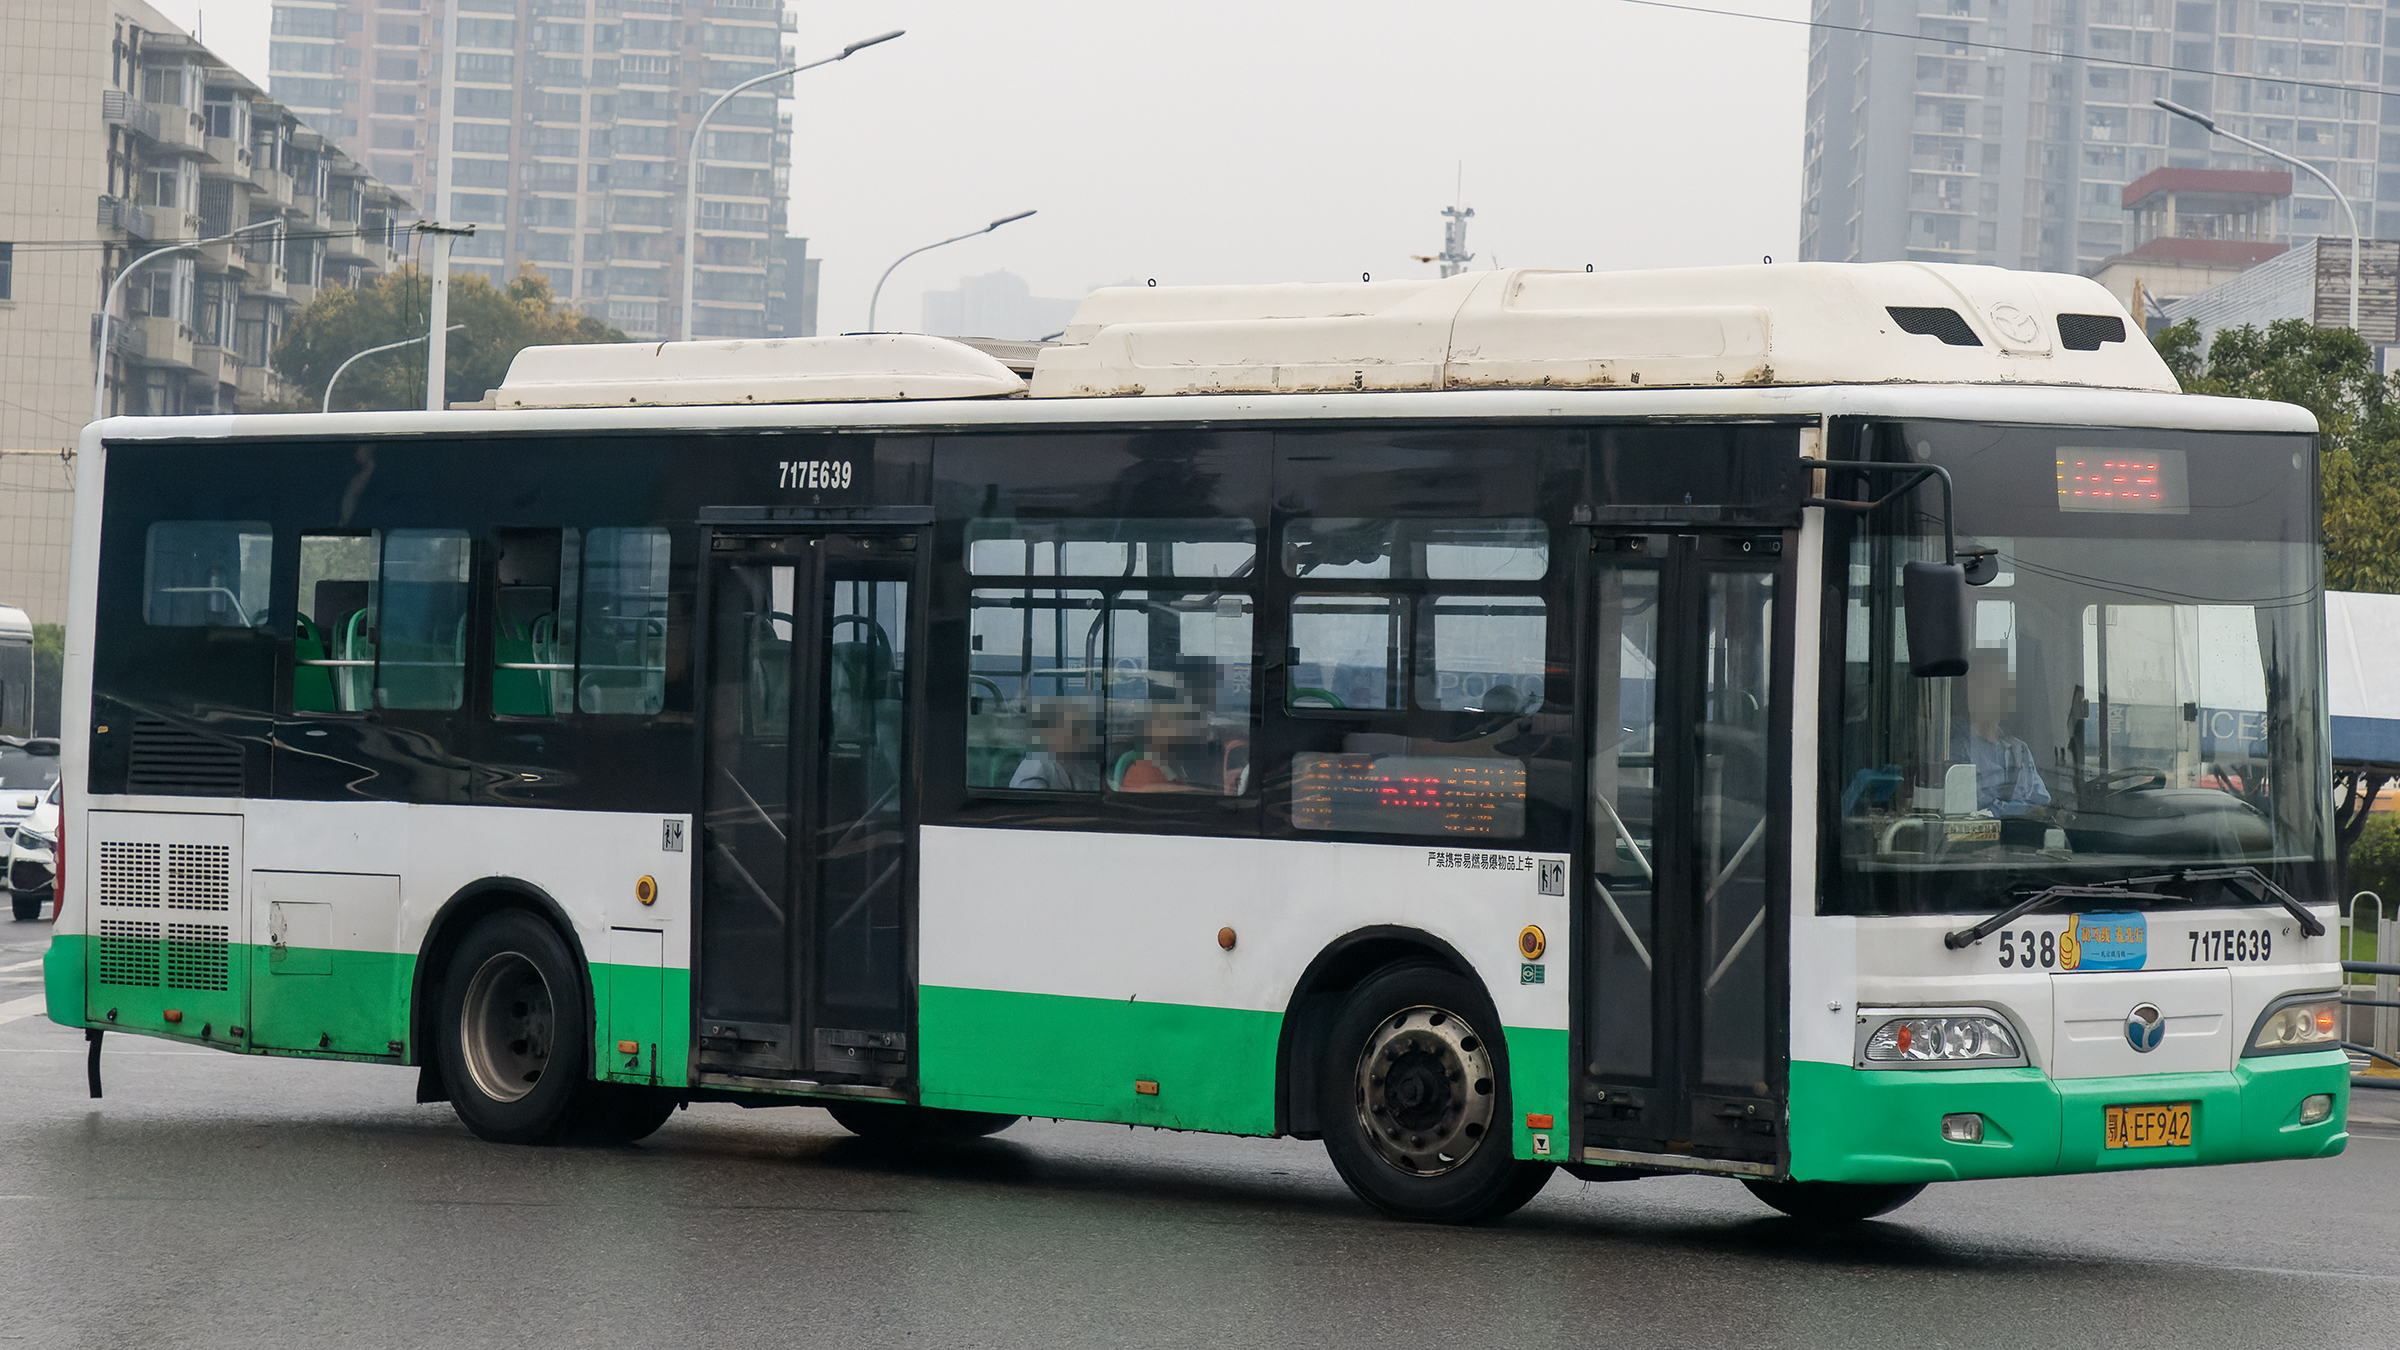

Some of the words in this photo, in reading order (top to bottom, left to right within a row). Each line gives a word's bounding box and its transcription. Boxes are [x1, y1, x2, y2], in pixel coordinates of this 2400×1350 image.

[779, 460, 852, 490] 717E639
[1427, 851, 1534, 872] 严禁携带易燃易爆物品上车
[1998, 930, 2056, 969] 538
[2188, 929, 2272, 963] 717E639
